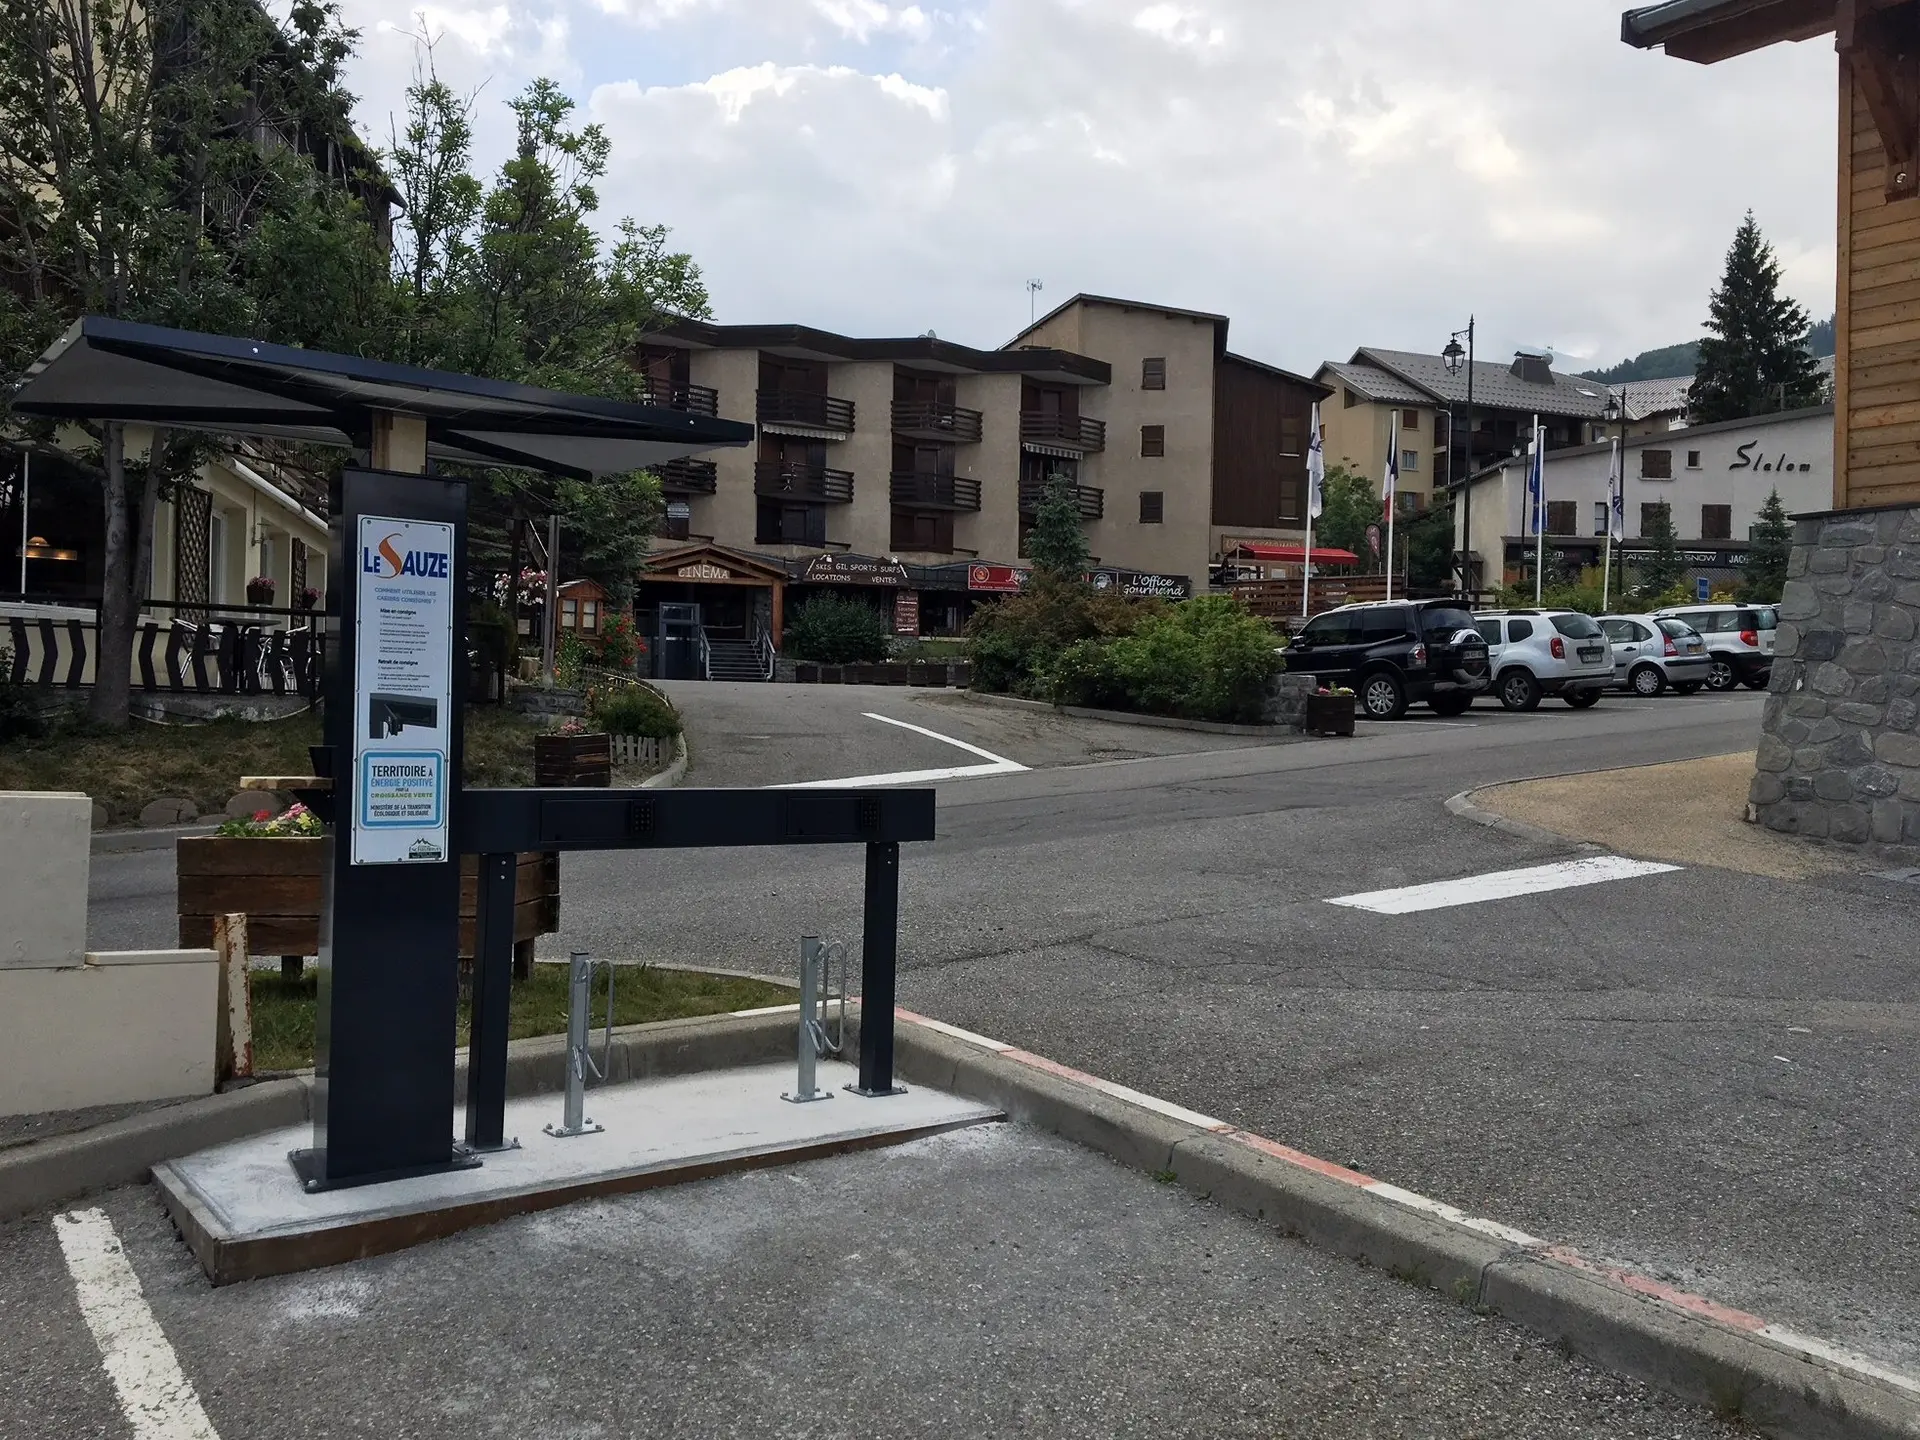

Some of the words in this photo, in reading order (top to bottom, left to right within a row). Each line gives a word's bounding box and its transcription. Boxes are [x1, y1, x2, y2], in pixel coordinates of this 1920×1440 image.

[1728, 439, 1811, 472] Slalom
[363, 546, 381, 573] LE
[374, 532, 449, 579] SAUZE
[1684, 554, 1717, 562] SNOW
[678, 564, 730, 579] CINEMA
[815, 563, 832, 571] SKIS
[835, 562, 848, 570] GIL
[849, 563, 878, 572] SPORTS
[880, 566, 901, 574] SURFS
[811, 573, 851, 582] LOCATIONS
[871, 576, 897, 584] VENTES
[1132, 575, 1175, 588] L'Office
[1123, 583, 1185, 596] Gourmand
[371, 765, 427, 777] TERRITOIRE
[402, 778, 433, 788] POSITIVE
